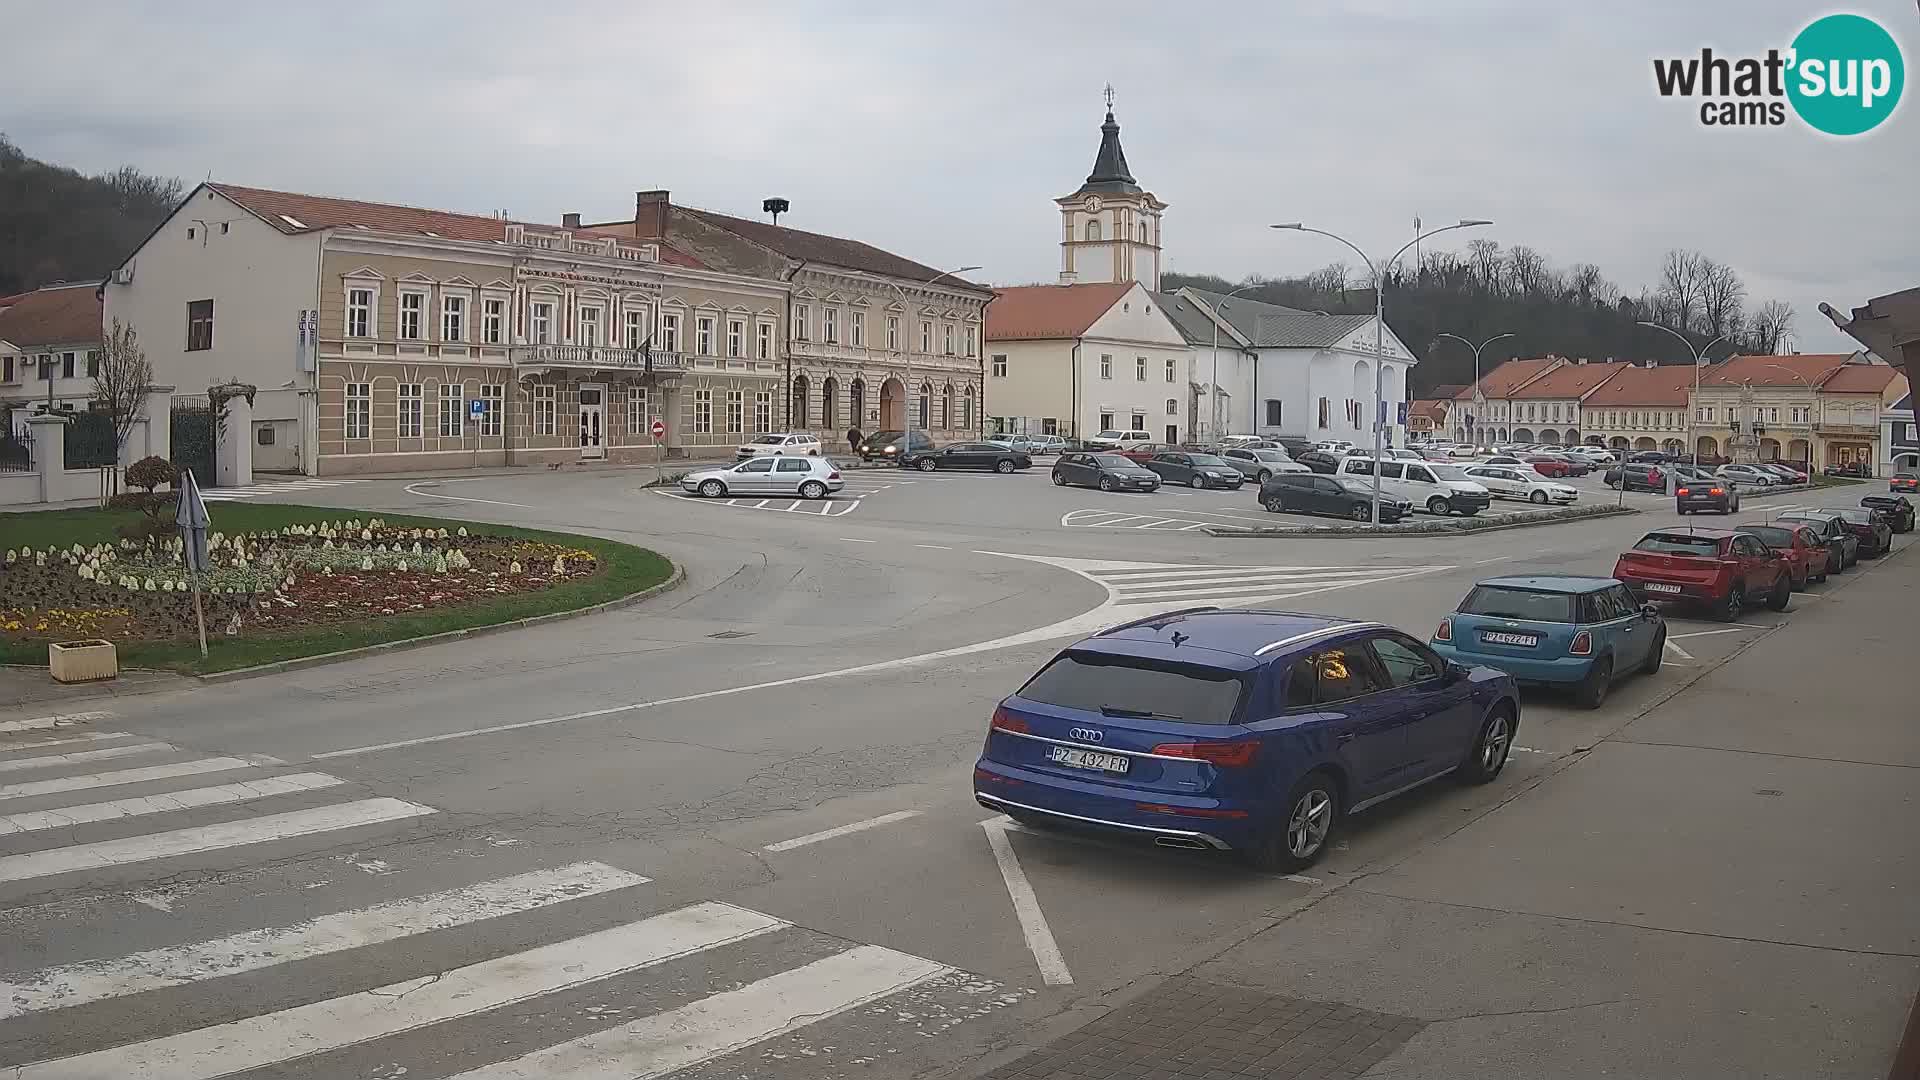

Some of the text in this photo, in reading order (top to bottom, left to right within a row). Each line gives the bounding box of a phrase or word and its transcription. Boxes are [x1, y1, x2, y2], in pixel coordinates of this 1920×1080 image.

[474, 401, 480, 411] P
[1487, 632, 1499, 640] PZ
[1054, 748, 1071, 762] PZ
